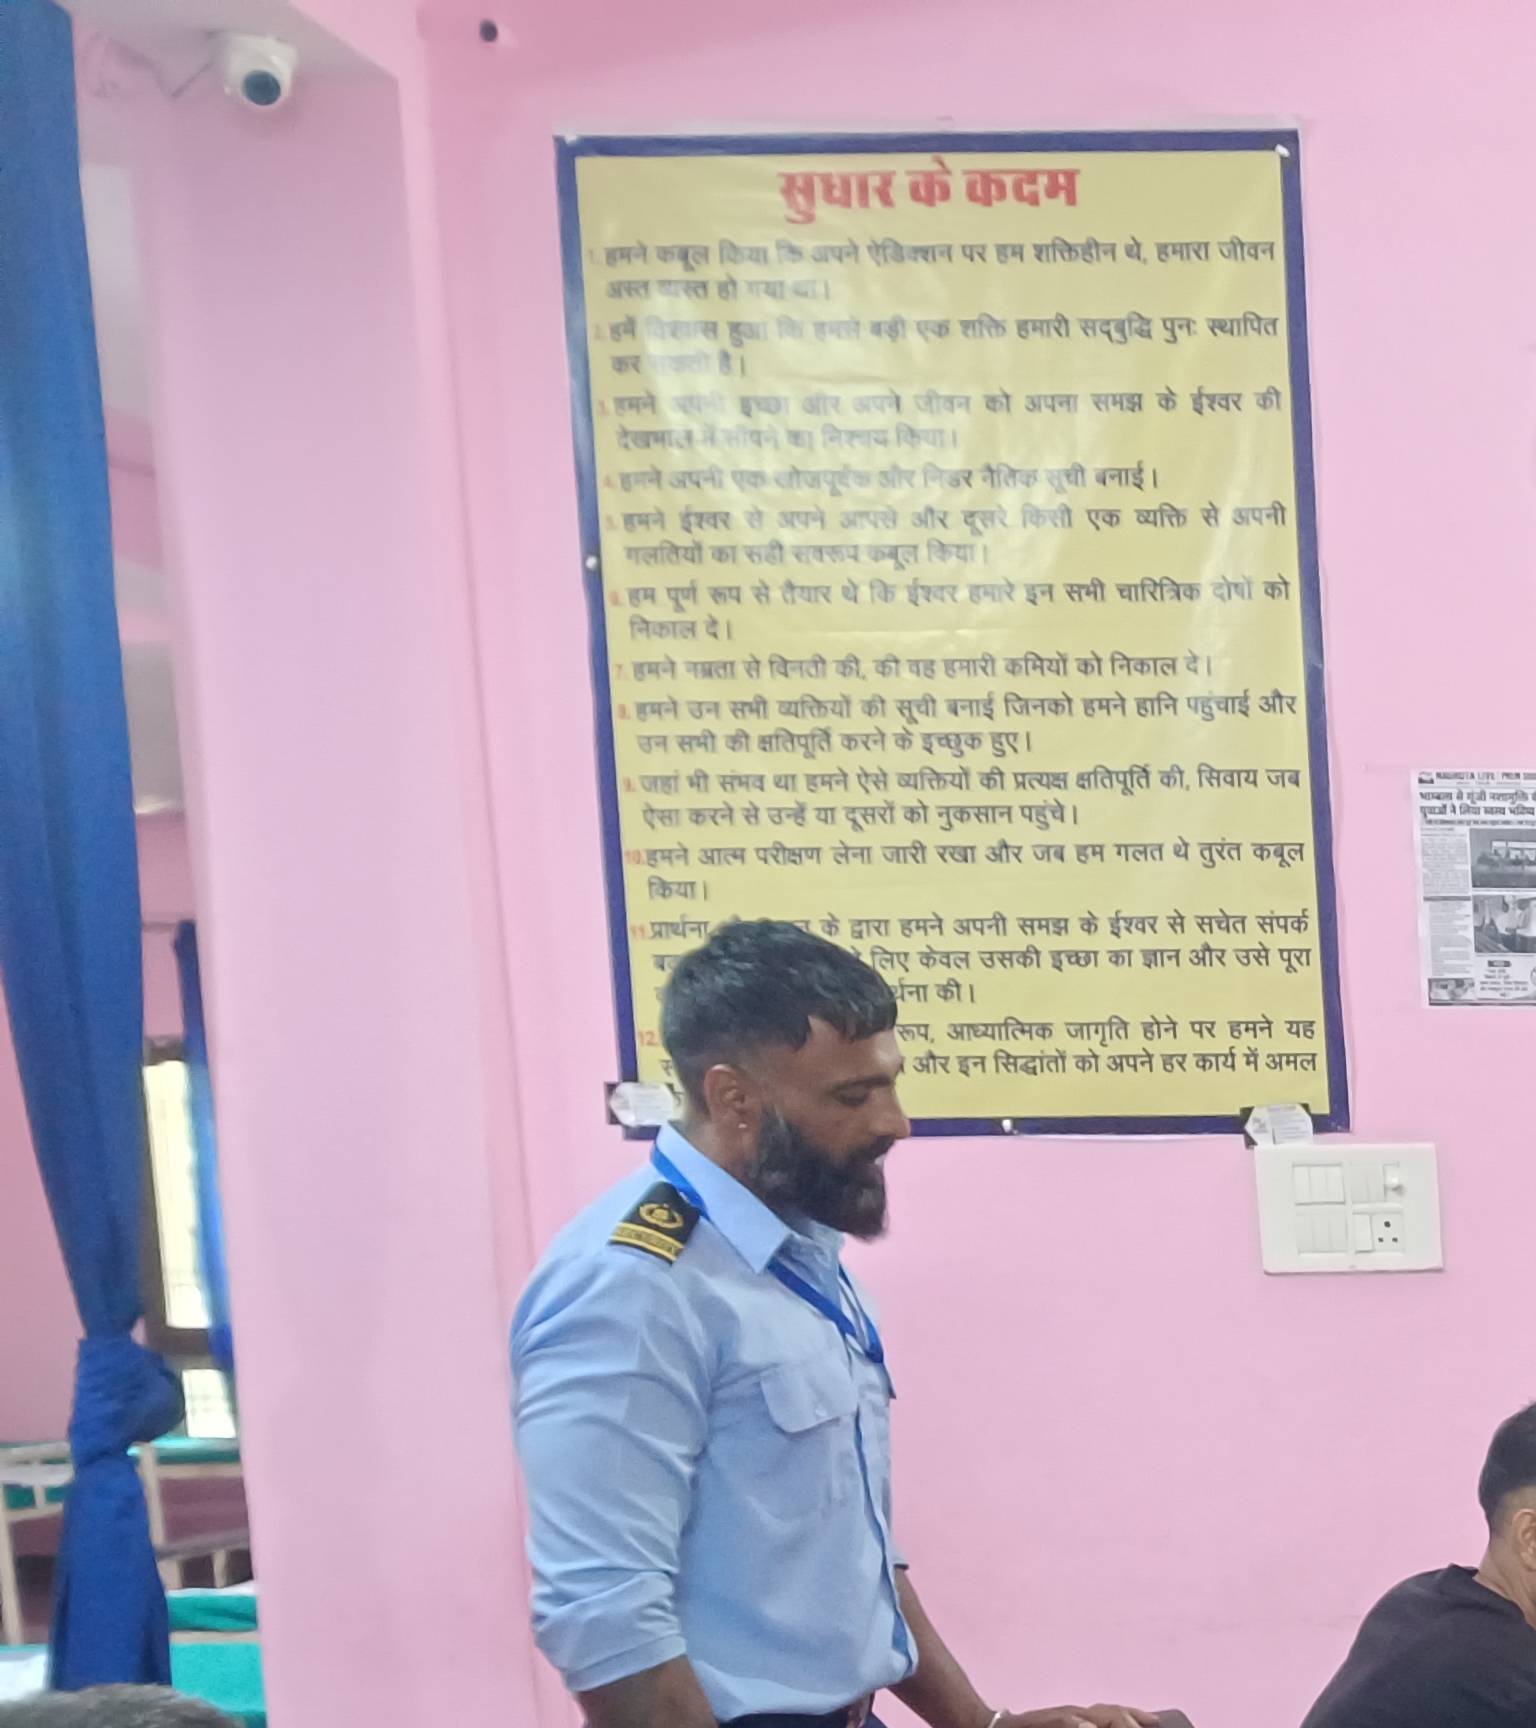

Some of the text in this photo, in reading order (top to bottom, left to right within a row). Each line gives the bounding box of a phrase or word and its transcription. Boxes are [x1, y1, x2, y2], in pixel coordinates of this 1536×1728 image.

[778, 154, 1080, 224] सुधार के कदम
[645, 842, 689, 868] हमने
[698, 848, 746, 865] आत्म
[754, 841, 822, 865] परीक्षण
[830, 840, 872, 864] लेना
[881, 840, 927, 864] जारी
[935, 845, 977, 863] रखा
[985, 839, 1023, 863] और
[1032, 844, 1065, 863] जब
[1075, 844, 1105, 864] हम
[1114, 843, 1164, 862] गलत
[1173, 836, 1190, 861] थे
[1198, 837, 1242, 869] तुरंत
[1251, 843, 1304, 868] कबूल
[649, 908, 1309, 939] प्रार्थना के द्वारा हमने अपनी समझ के ईश्वर से सचेत संपर्क
[870, 941, 1311, 973] लिए केवल उसकी इच्छा का ज्ञान और उसे पूरा
